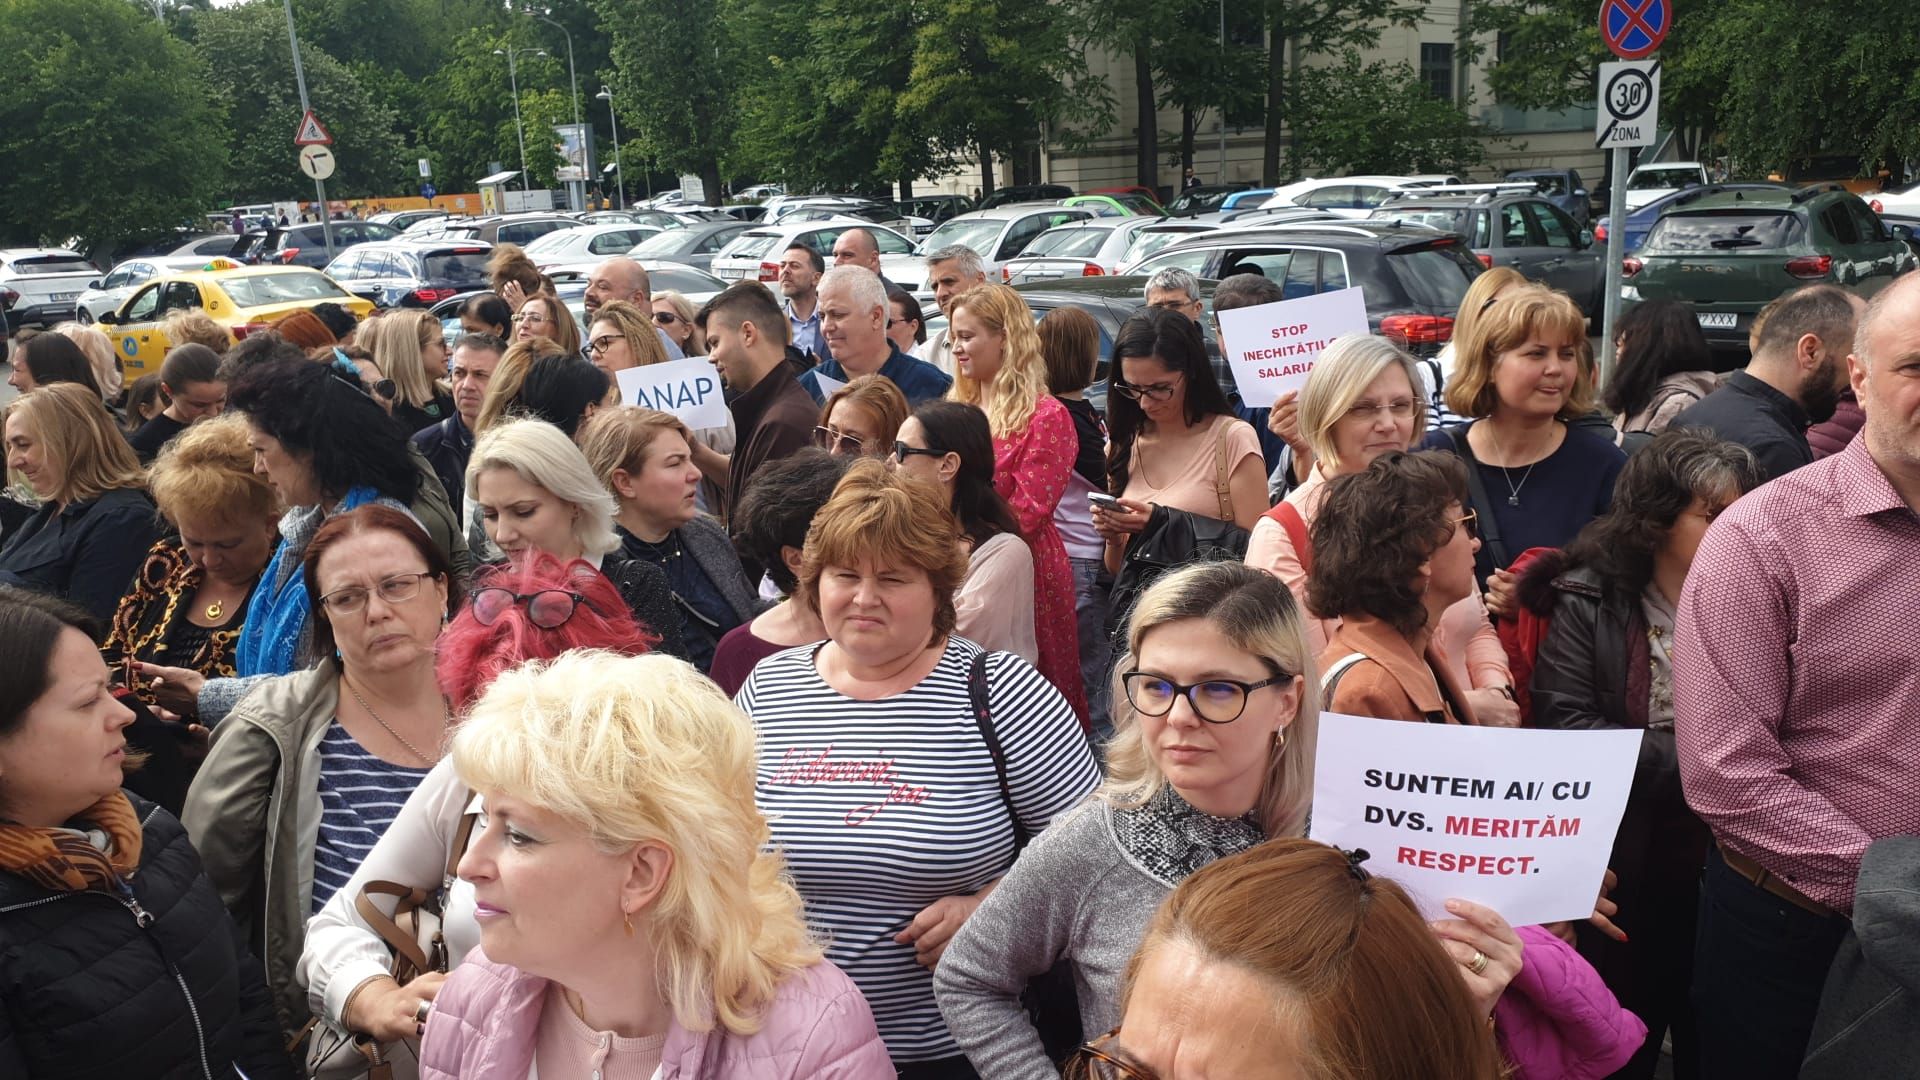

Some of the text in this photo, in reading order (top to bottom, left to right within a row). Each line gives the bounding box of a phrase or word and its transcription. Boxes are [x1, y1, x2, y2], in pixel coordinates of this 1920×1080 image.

[1616, 82, 1641, 107] 30
[1611, 126, 1640, 142] ZONA
[1271, 323, 1308, 339] STOP
[637, 377, 713, 411] ANAP
[1364, 768, 1495, 799] SUNTEM
[1552, 781, 1592, 800] CU
[1364, 804, 1581, 839] DVS. MERITĂM
[1397, 846, 1540, 875] RESPECT.
